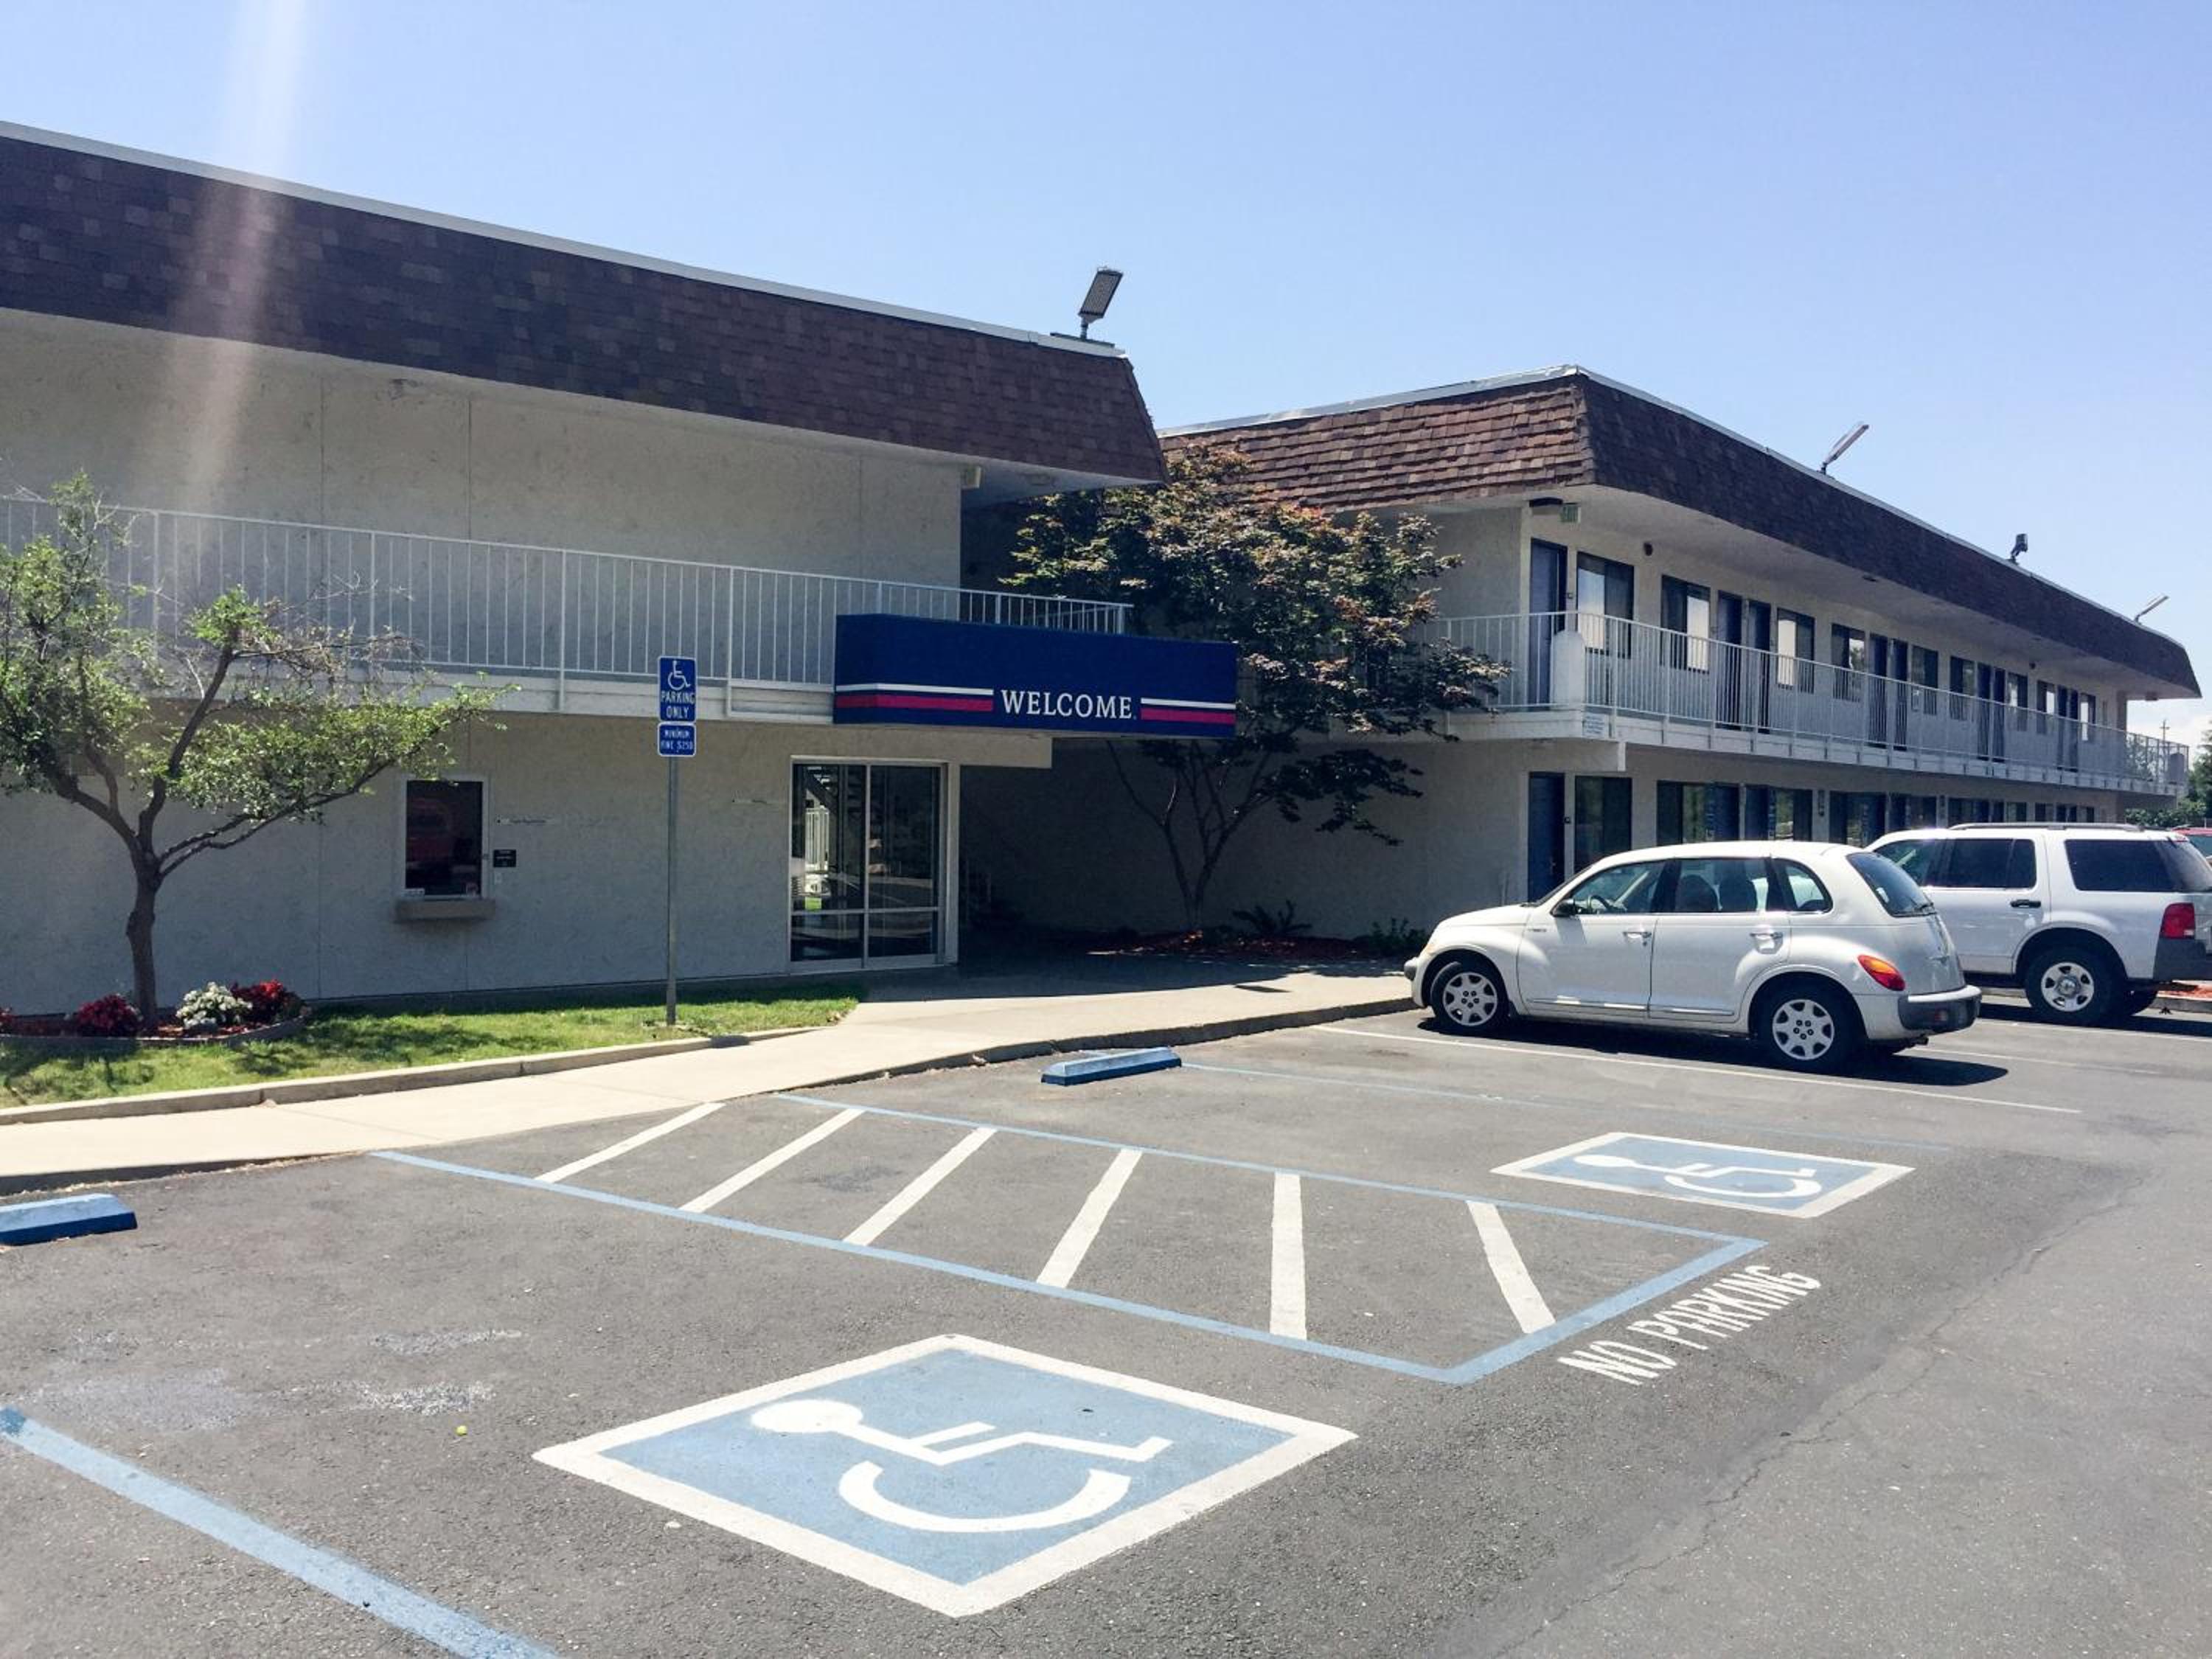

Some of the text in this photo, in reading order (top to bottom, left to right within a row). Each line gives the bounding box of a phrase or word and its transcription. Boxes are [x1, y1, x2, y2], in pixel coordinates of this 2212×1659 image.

[661, 690, 695, 705] PARKING
[1001, 689, 1133, 720] WELCOME
[666, 706, 689, 719] ONLY
[1557, 1265, 1821, 1386] NO PARKING
